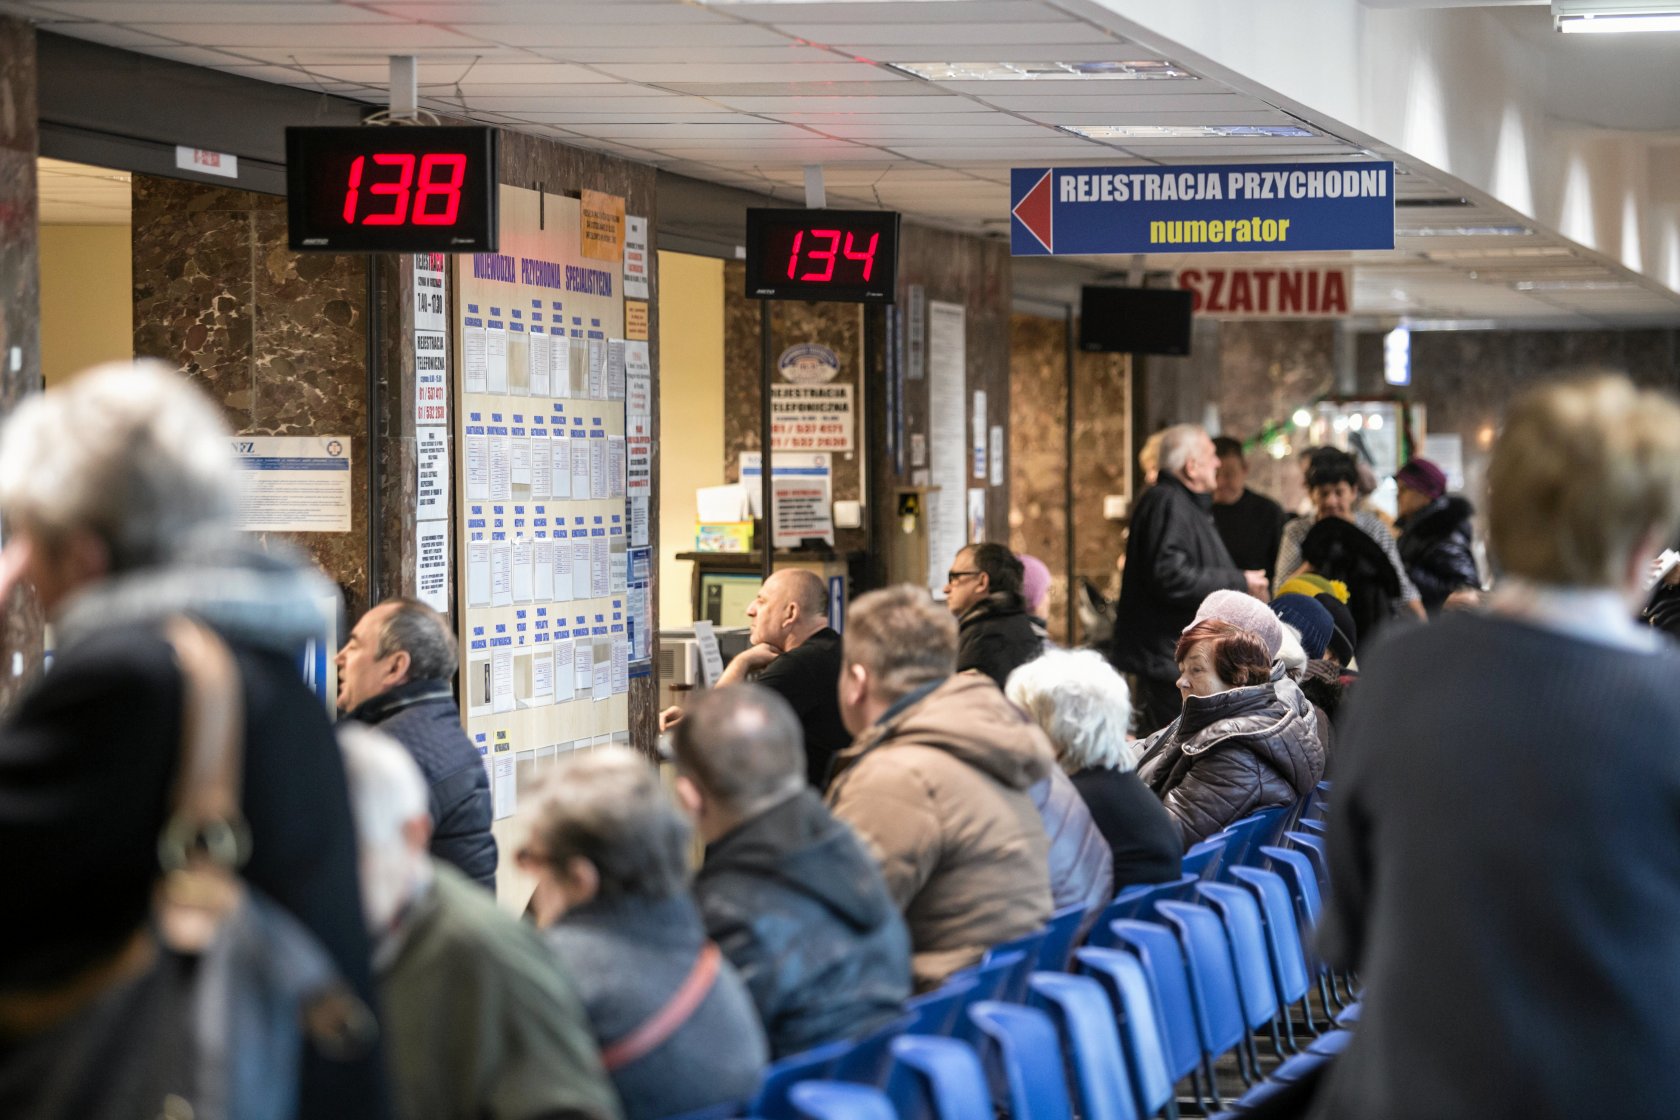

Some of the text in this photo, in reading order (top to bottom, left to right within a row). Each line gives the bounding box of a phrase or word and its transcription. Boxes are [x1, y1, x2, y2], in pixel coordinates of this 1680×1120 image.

[343, 152, 467, 226] 138
[1060, 169, 1387, 203] REJESTRACJA PRZYCHODNI
[1150, 217, 1290, 244] numerator
[787, 229, 880, 282] 134
[521, 257, 561, 289] PRZYCHODNIA
[565, 264, 613, 298] SPECJALISTYCZNA
[1179, 269, 1350, 313] SZATNIA
[417, 336, 444, 350] REJESTRACJA
[417, 356, 445, 370] TELEFONICZNA
